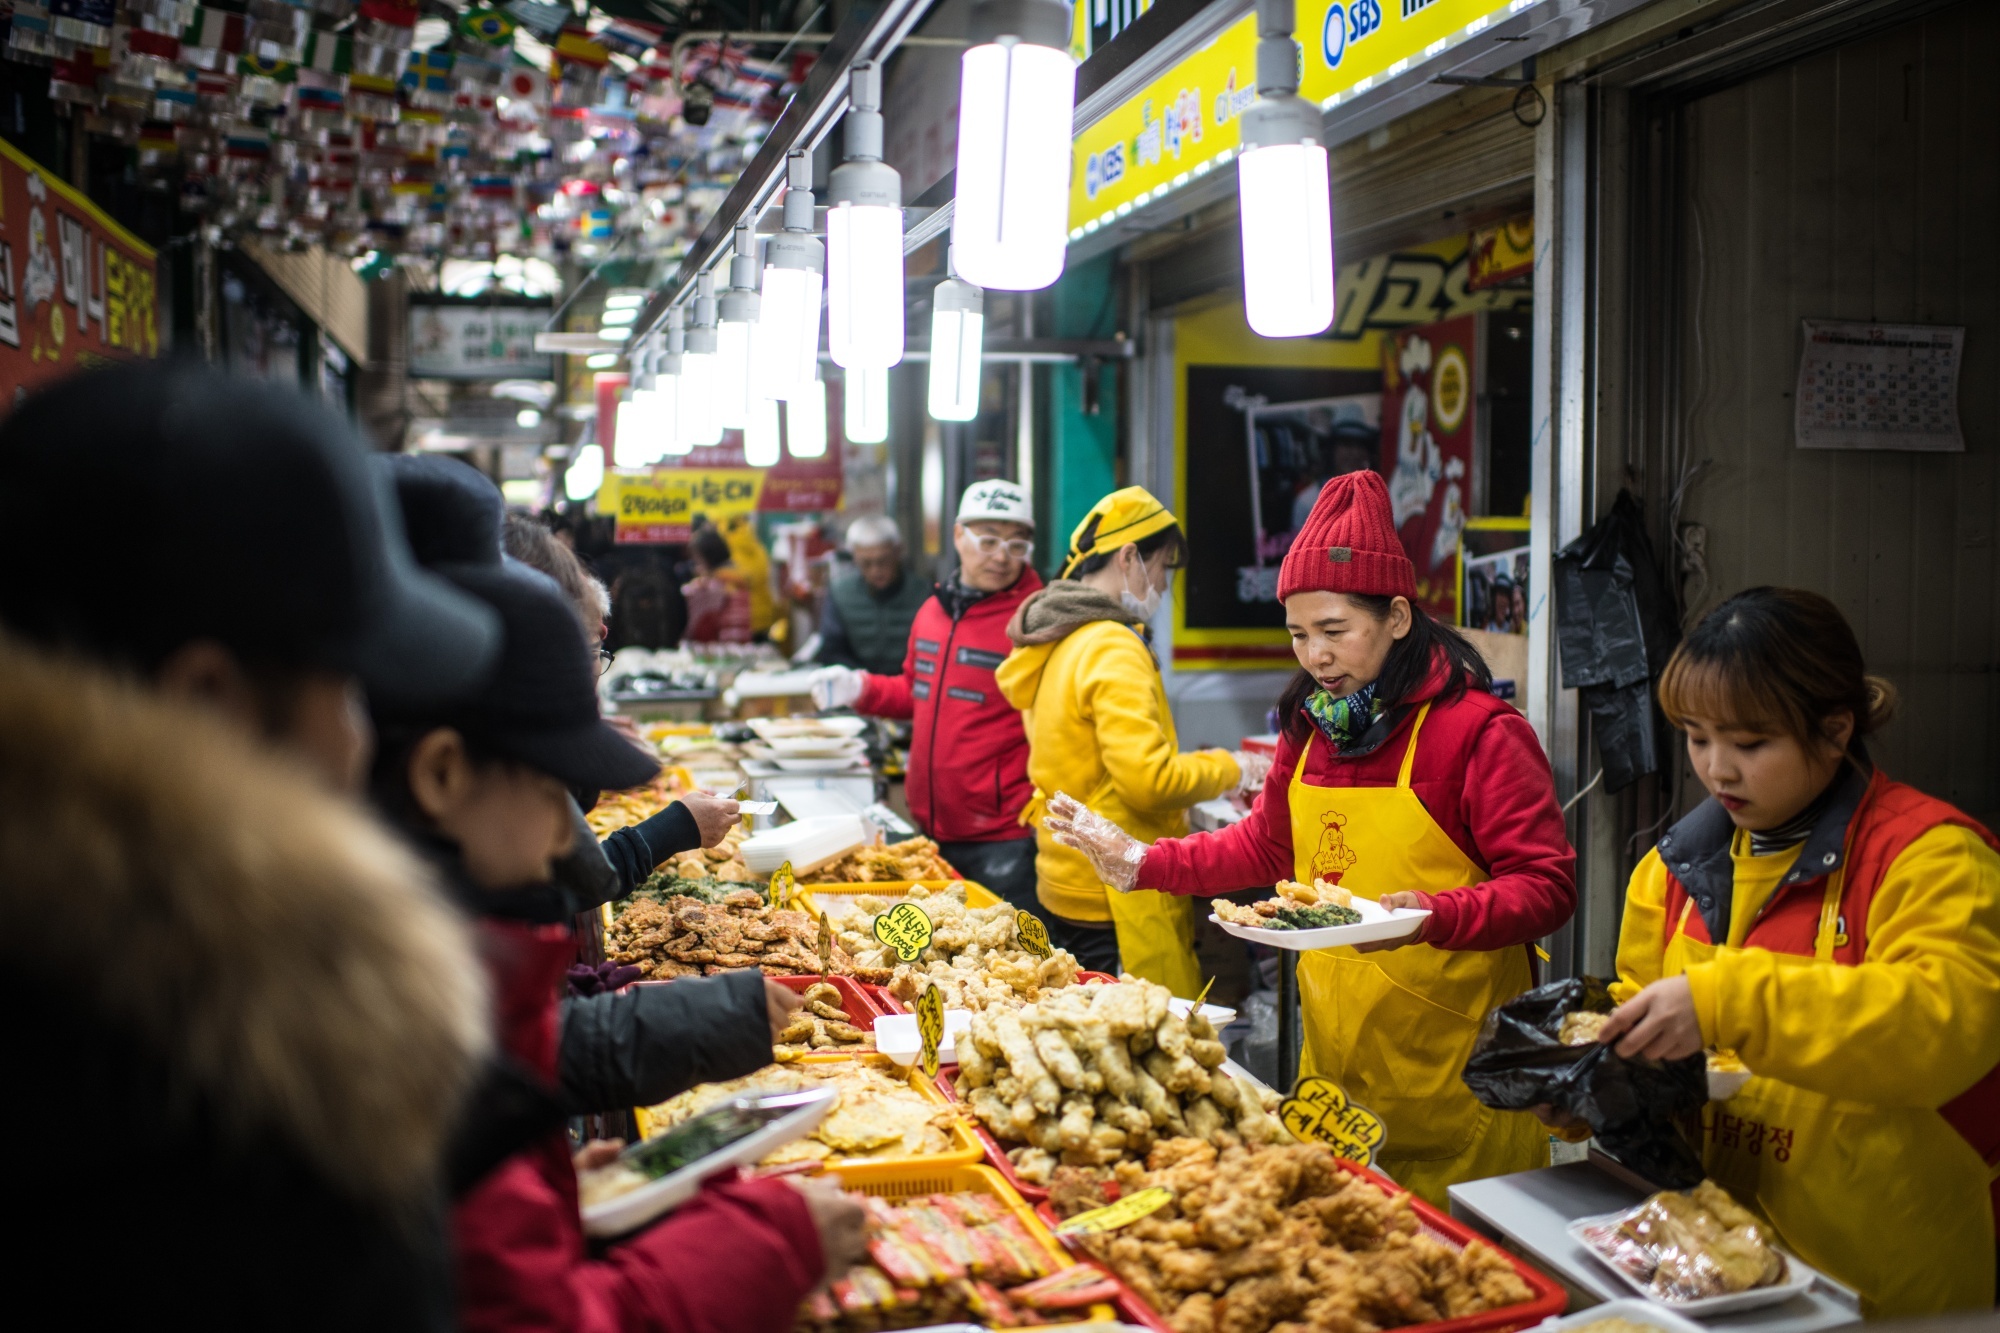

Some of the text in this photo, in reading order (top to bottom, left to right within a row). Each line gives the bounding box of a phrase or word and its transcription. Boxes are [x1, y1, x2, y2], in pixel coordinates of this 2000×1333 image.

[1349, 0, 1381, 43] SBS
[894, 905, 928, 943] 맛살전
[1302, 1081, 1378, 1143] 고추튀김
